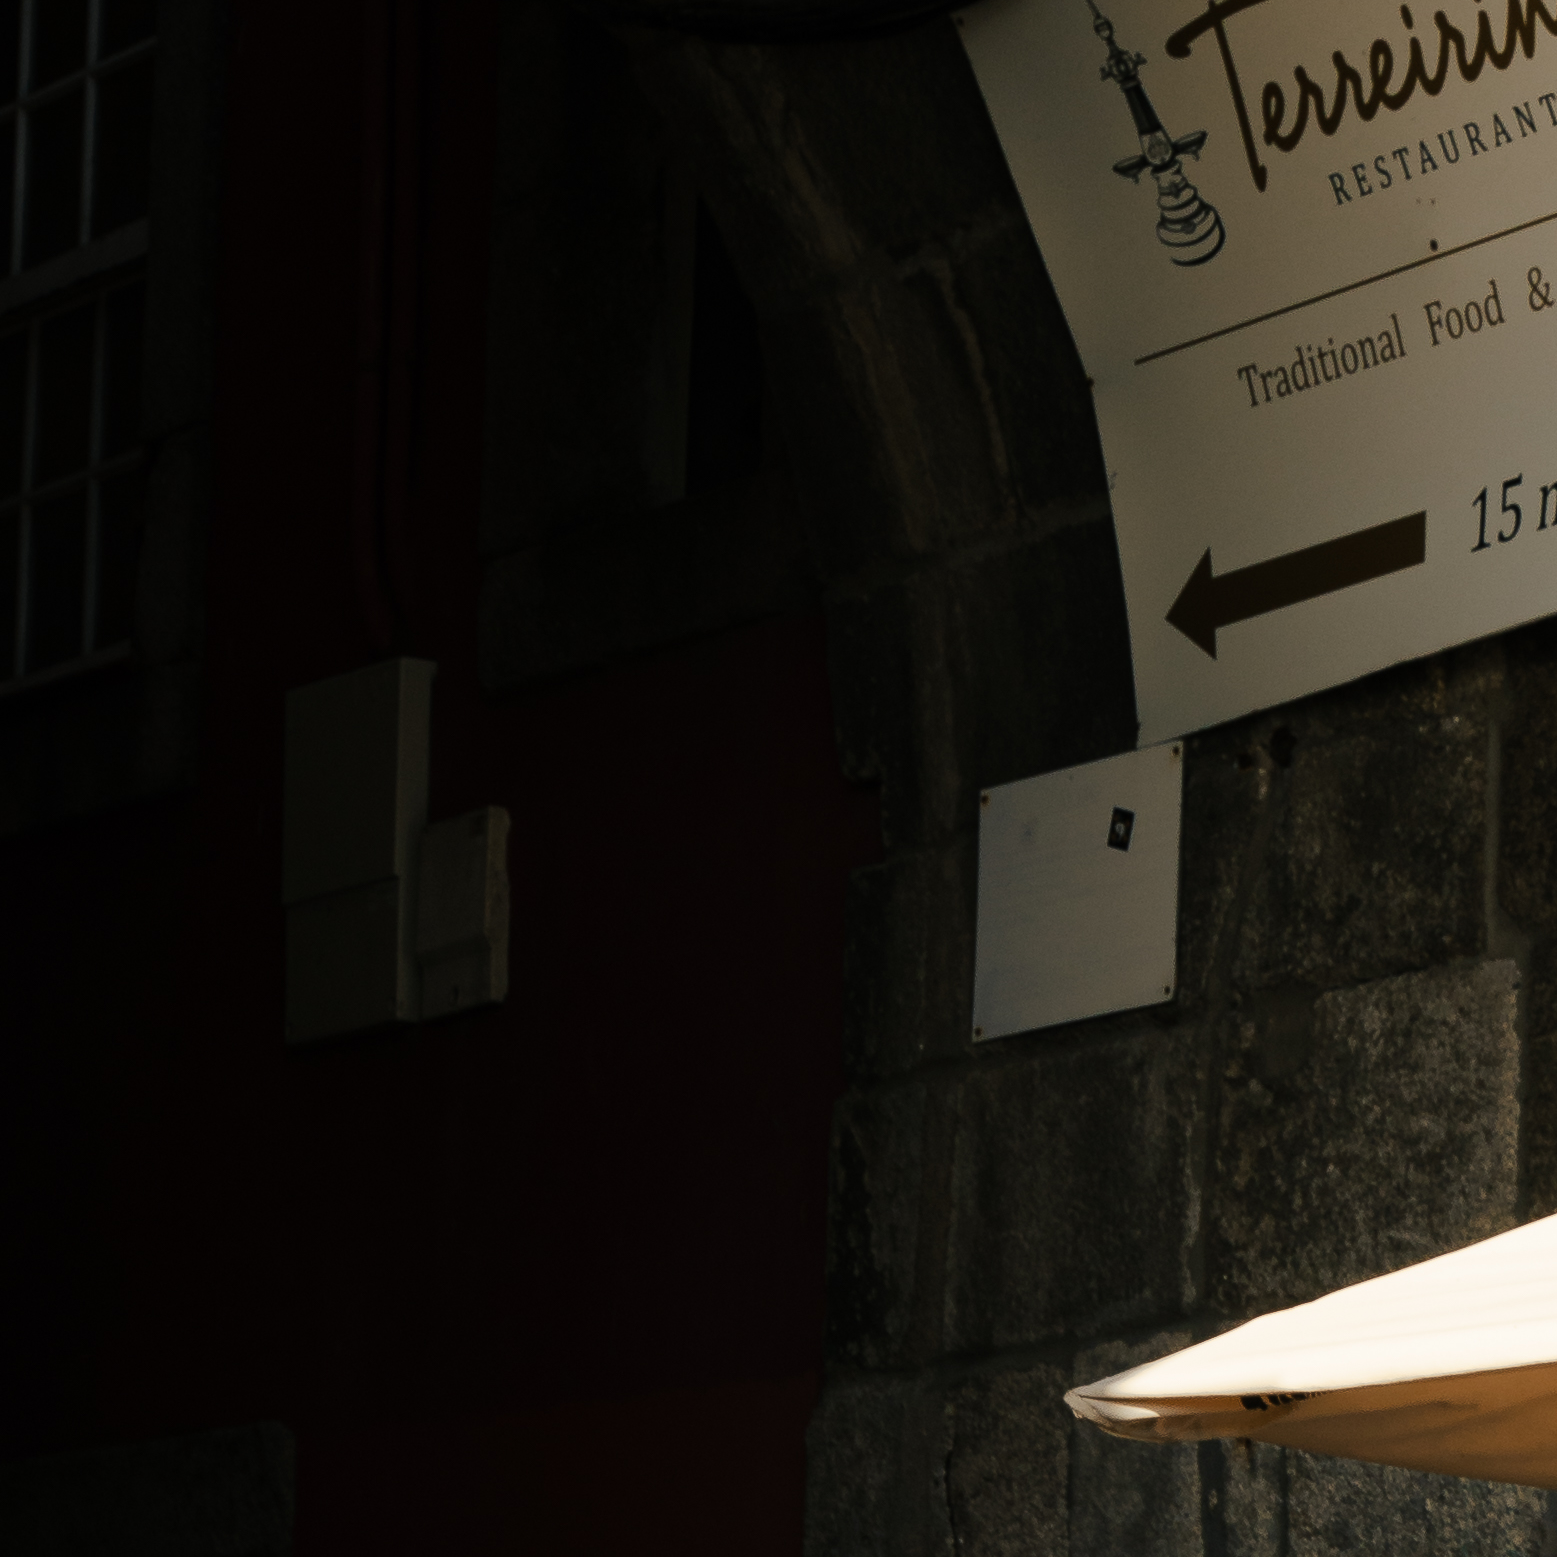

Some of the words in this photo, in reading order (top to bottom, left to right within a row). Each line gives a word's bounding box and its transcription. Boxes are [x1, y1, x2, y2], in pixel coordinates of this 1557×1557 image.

[1237, 312, 1407, 407] Traditional
[1423, 278, 1505, 346] Food
[1526, 265, 1554, 311] &
[1470, 472, 1523, 553] 15
